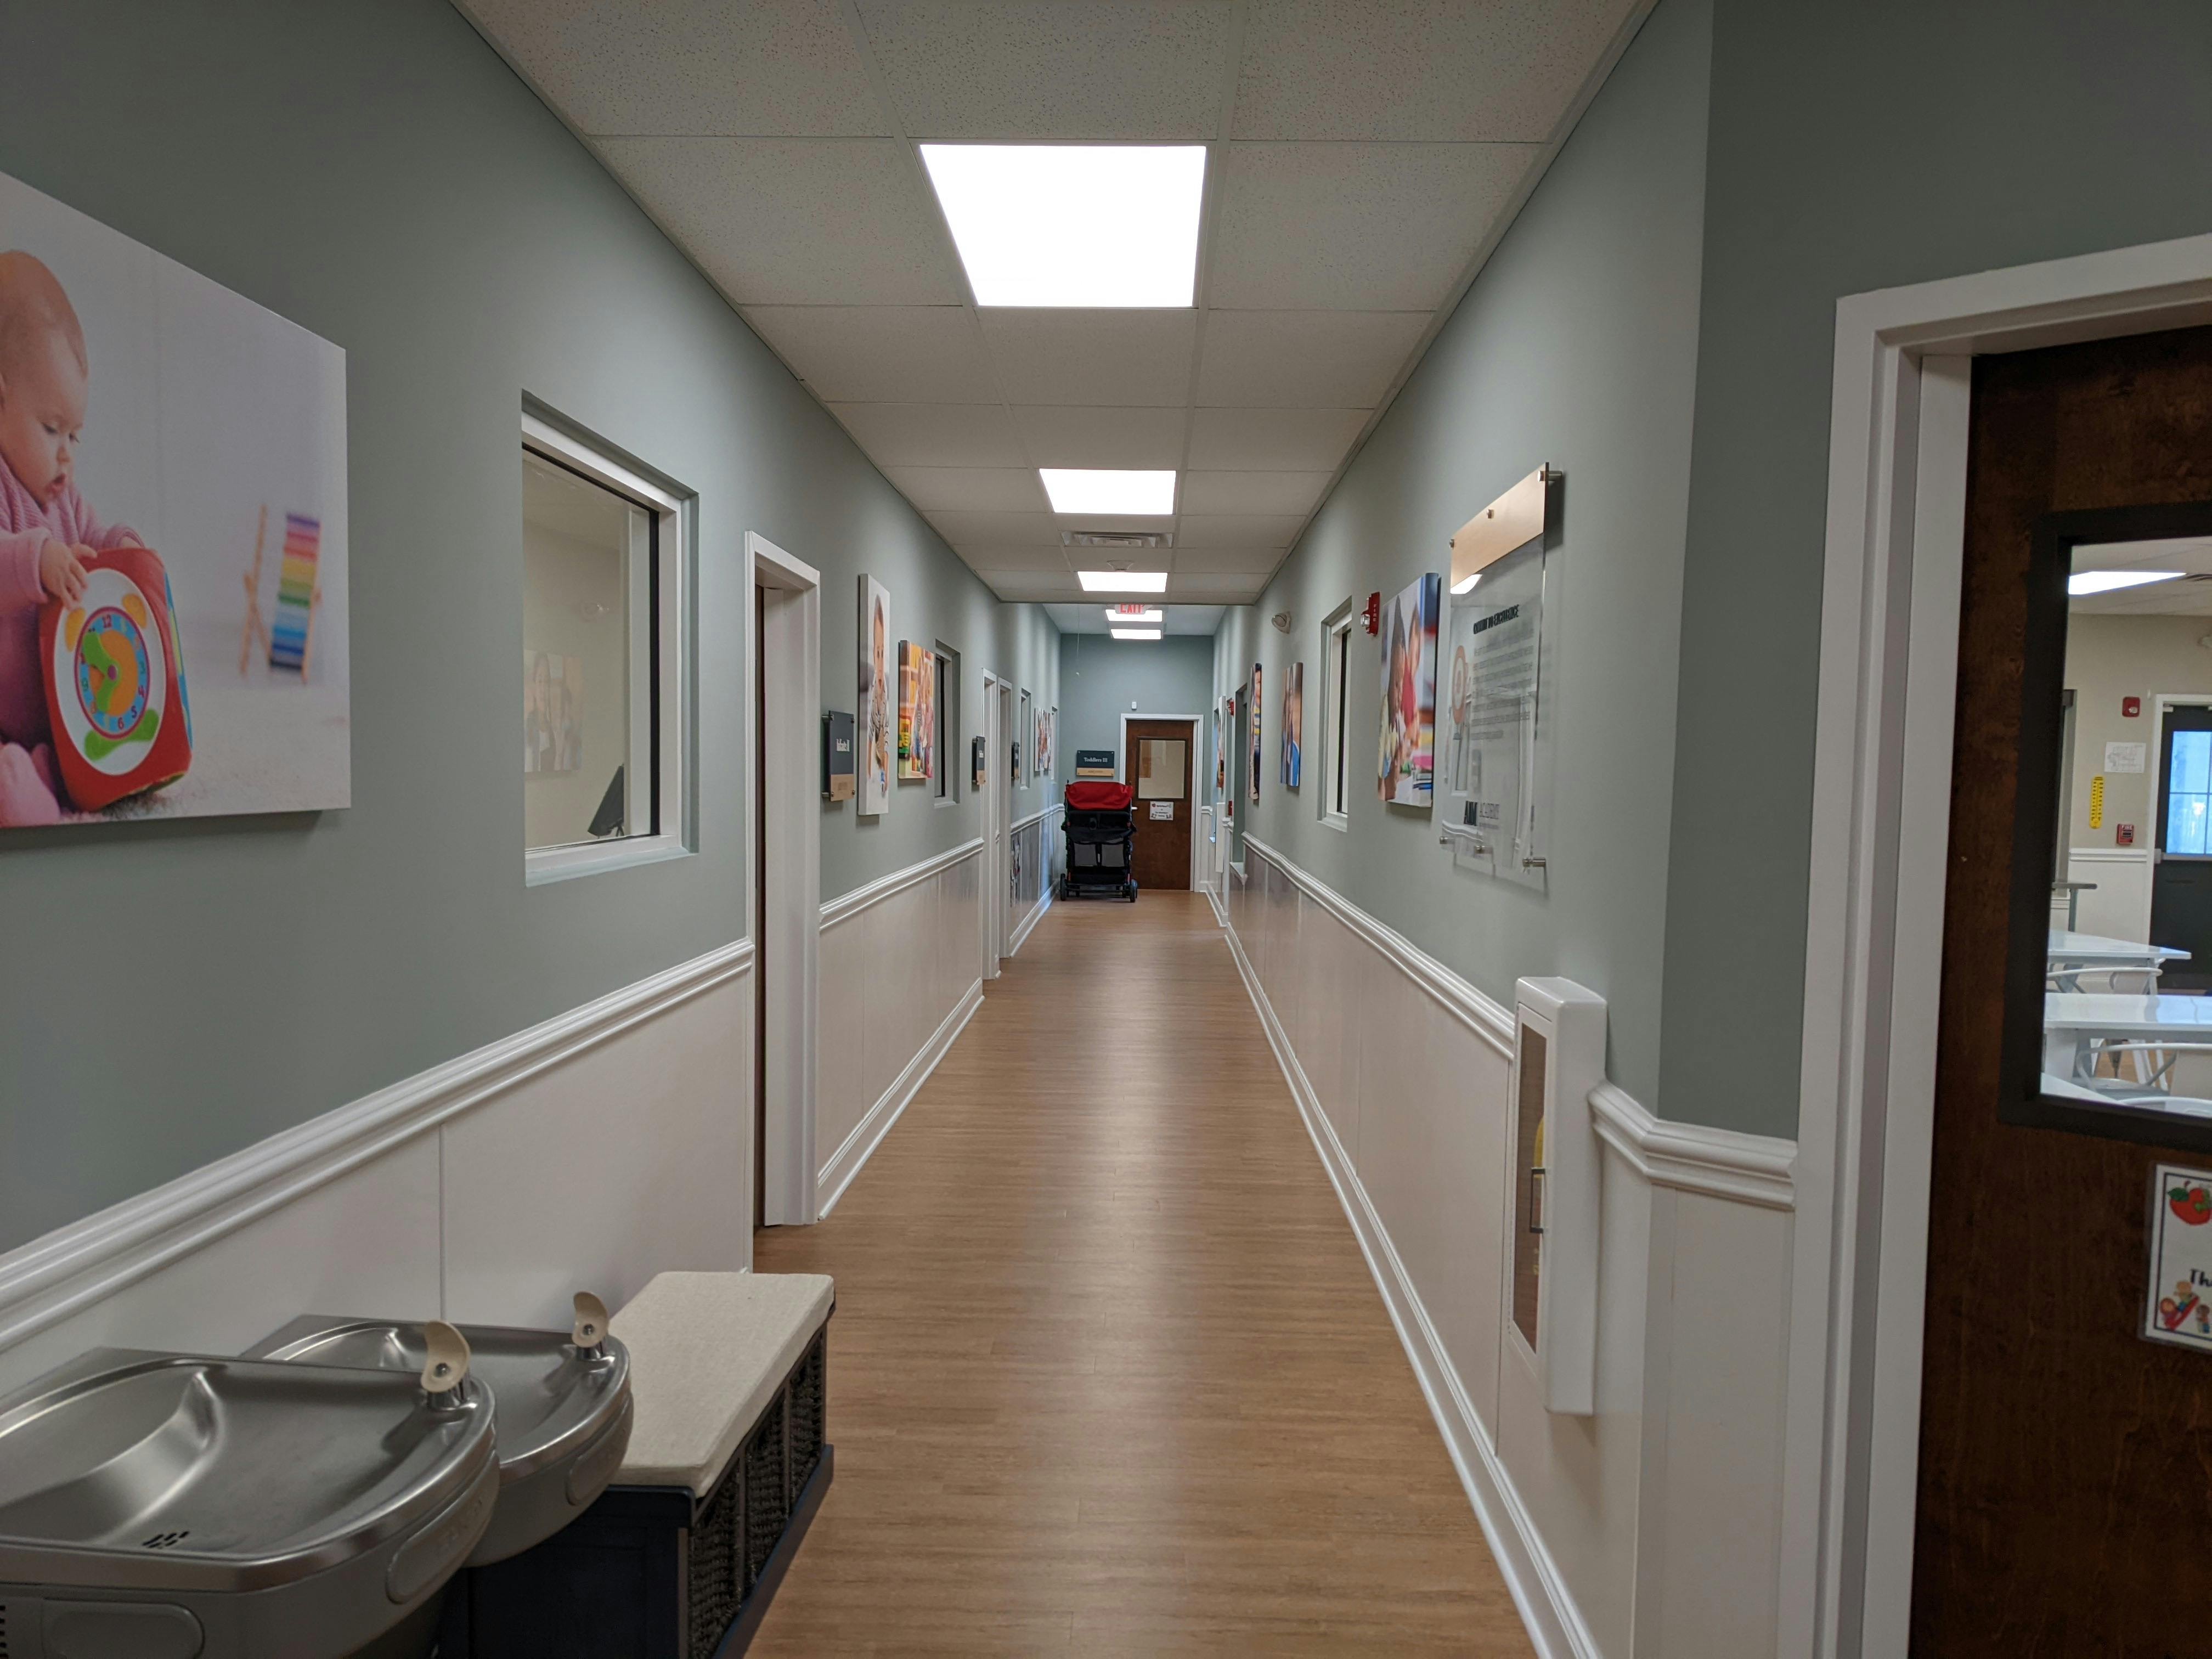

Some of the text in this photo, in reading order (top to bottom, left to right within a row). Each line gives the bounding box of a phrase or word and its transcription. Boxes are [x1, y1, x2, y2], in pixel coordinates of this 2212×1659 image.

[102, 614, 112, 628] 12
[138, 684, 145, 698] 4
[131, 705, 138, 719] 5
[117, 717, 124, 730] 6
